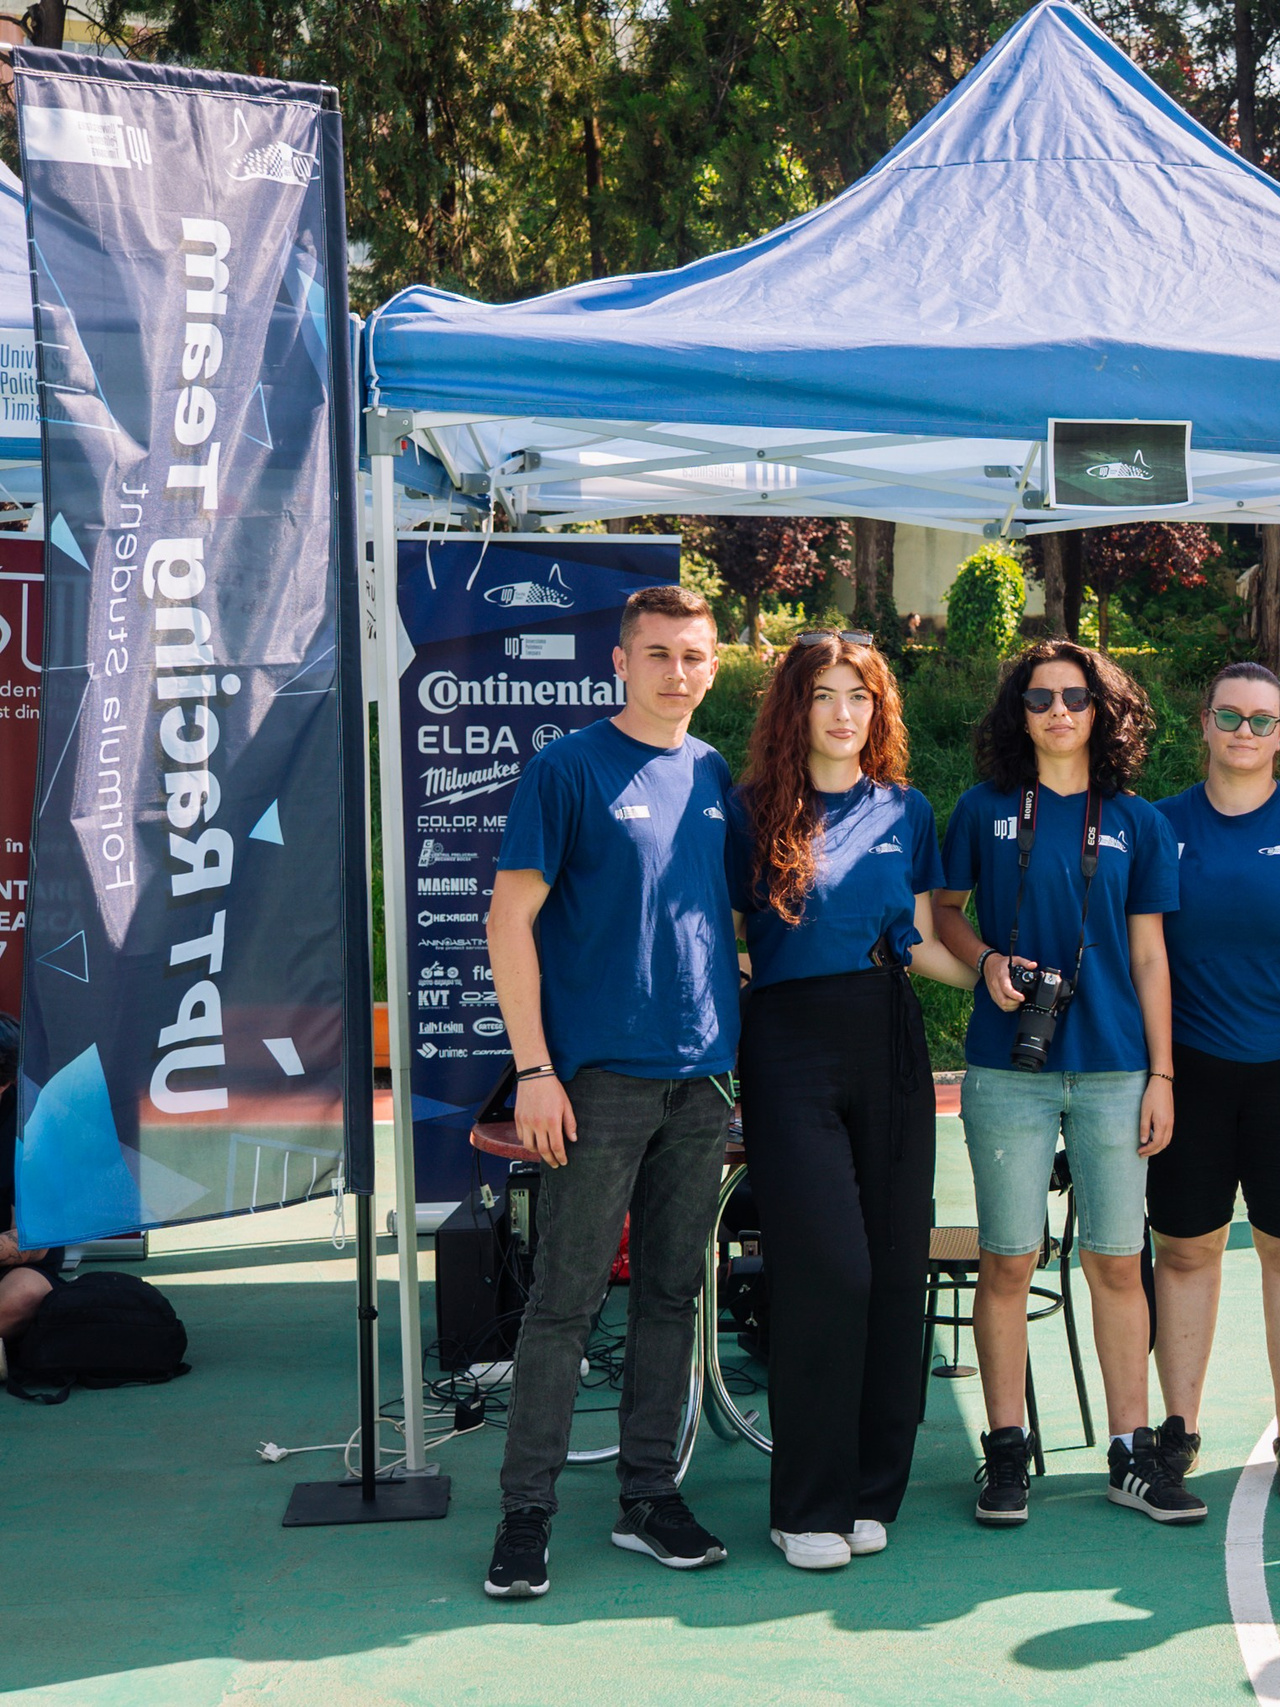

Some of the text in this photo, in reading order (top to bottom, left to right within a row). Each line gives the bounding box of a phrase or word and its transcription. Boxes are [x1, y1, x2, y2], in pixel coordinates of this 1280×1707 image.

[418, 669, 627, 715] Continental
[15, 704, 40, 719] din
[418, 725, 520, 754] ELBA
[419, 760, 520, 797] Milwaukee
[1024, 790, 1035, 820] Canon
[417, 815, 478, 828] COLOR
[1087, 826, 1097, 846] EOS
[417, 878, 478, 892] MAGNUS
[433, 913, 479, 923] HEXAGON
[418, 990, 450, 1006] KVT
[438, 1046, 468, 1058] unimec
